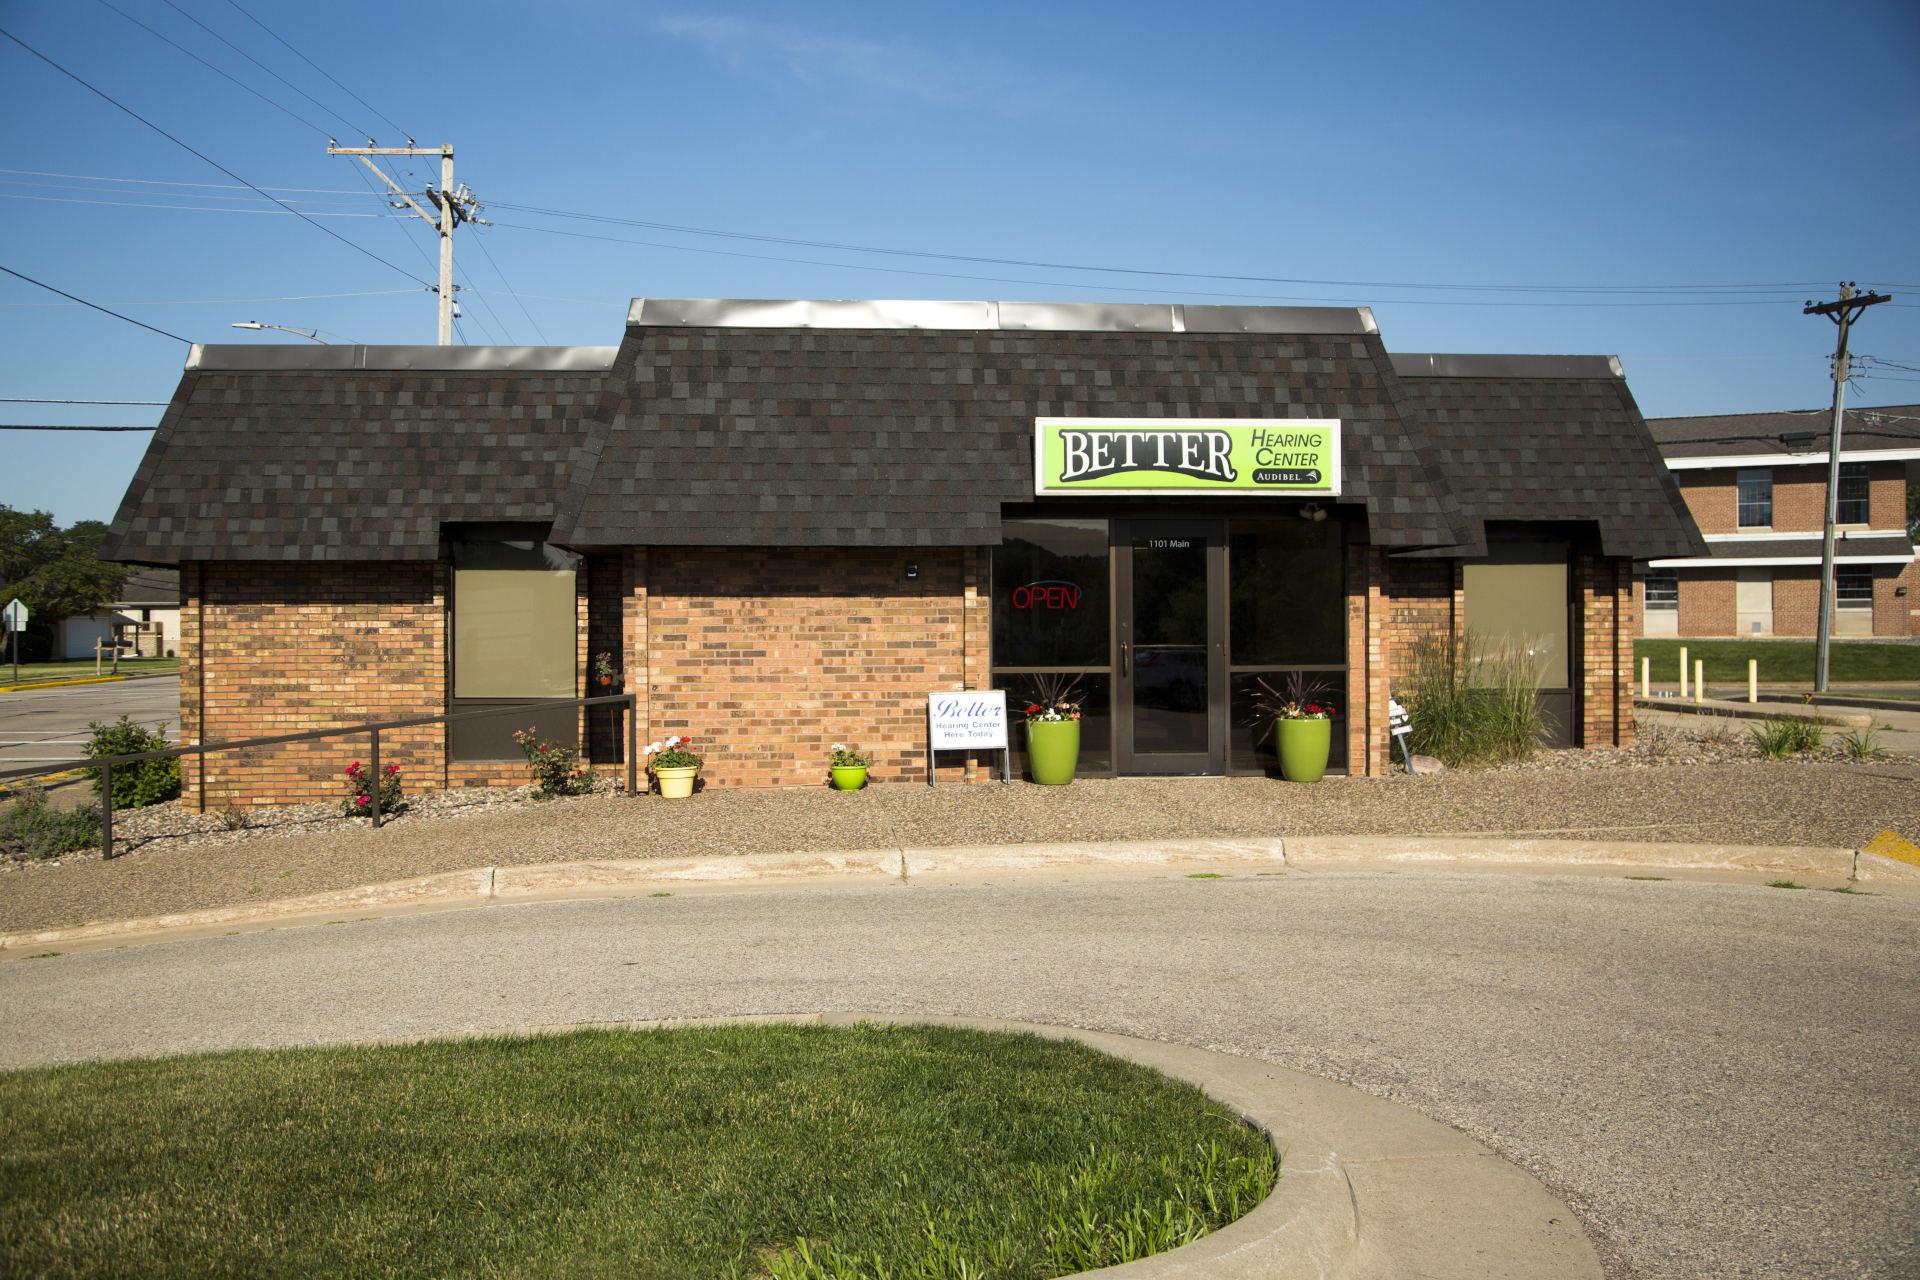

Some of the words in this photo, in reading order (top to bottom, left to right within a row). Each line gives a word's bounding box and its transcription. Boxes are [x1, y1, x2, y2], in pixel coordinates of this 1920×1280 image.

[1060, 430, 1237, 481] BETTER
[1256, 472, 1301, 481] AUDIBEL
[1149, 539, 1168, 548] 1101
[1169, 539, 1190, 548] Main
[1013, 586, 1078, 609] OPEN
[933, 699, 1002, 718] Better
[936, 722, 969, 730] Hearing
[972, 721, 1001, 729] Center
[967, 730, 994, 738] Today
